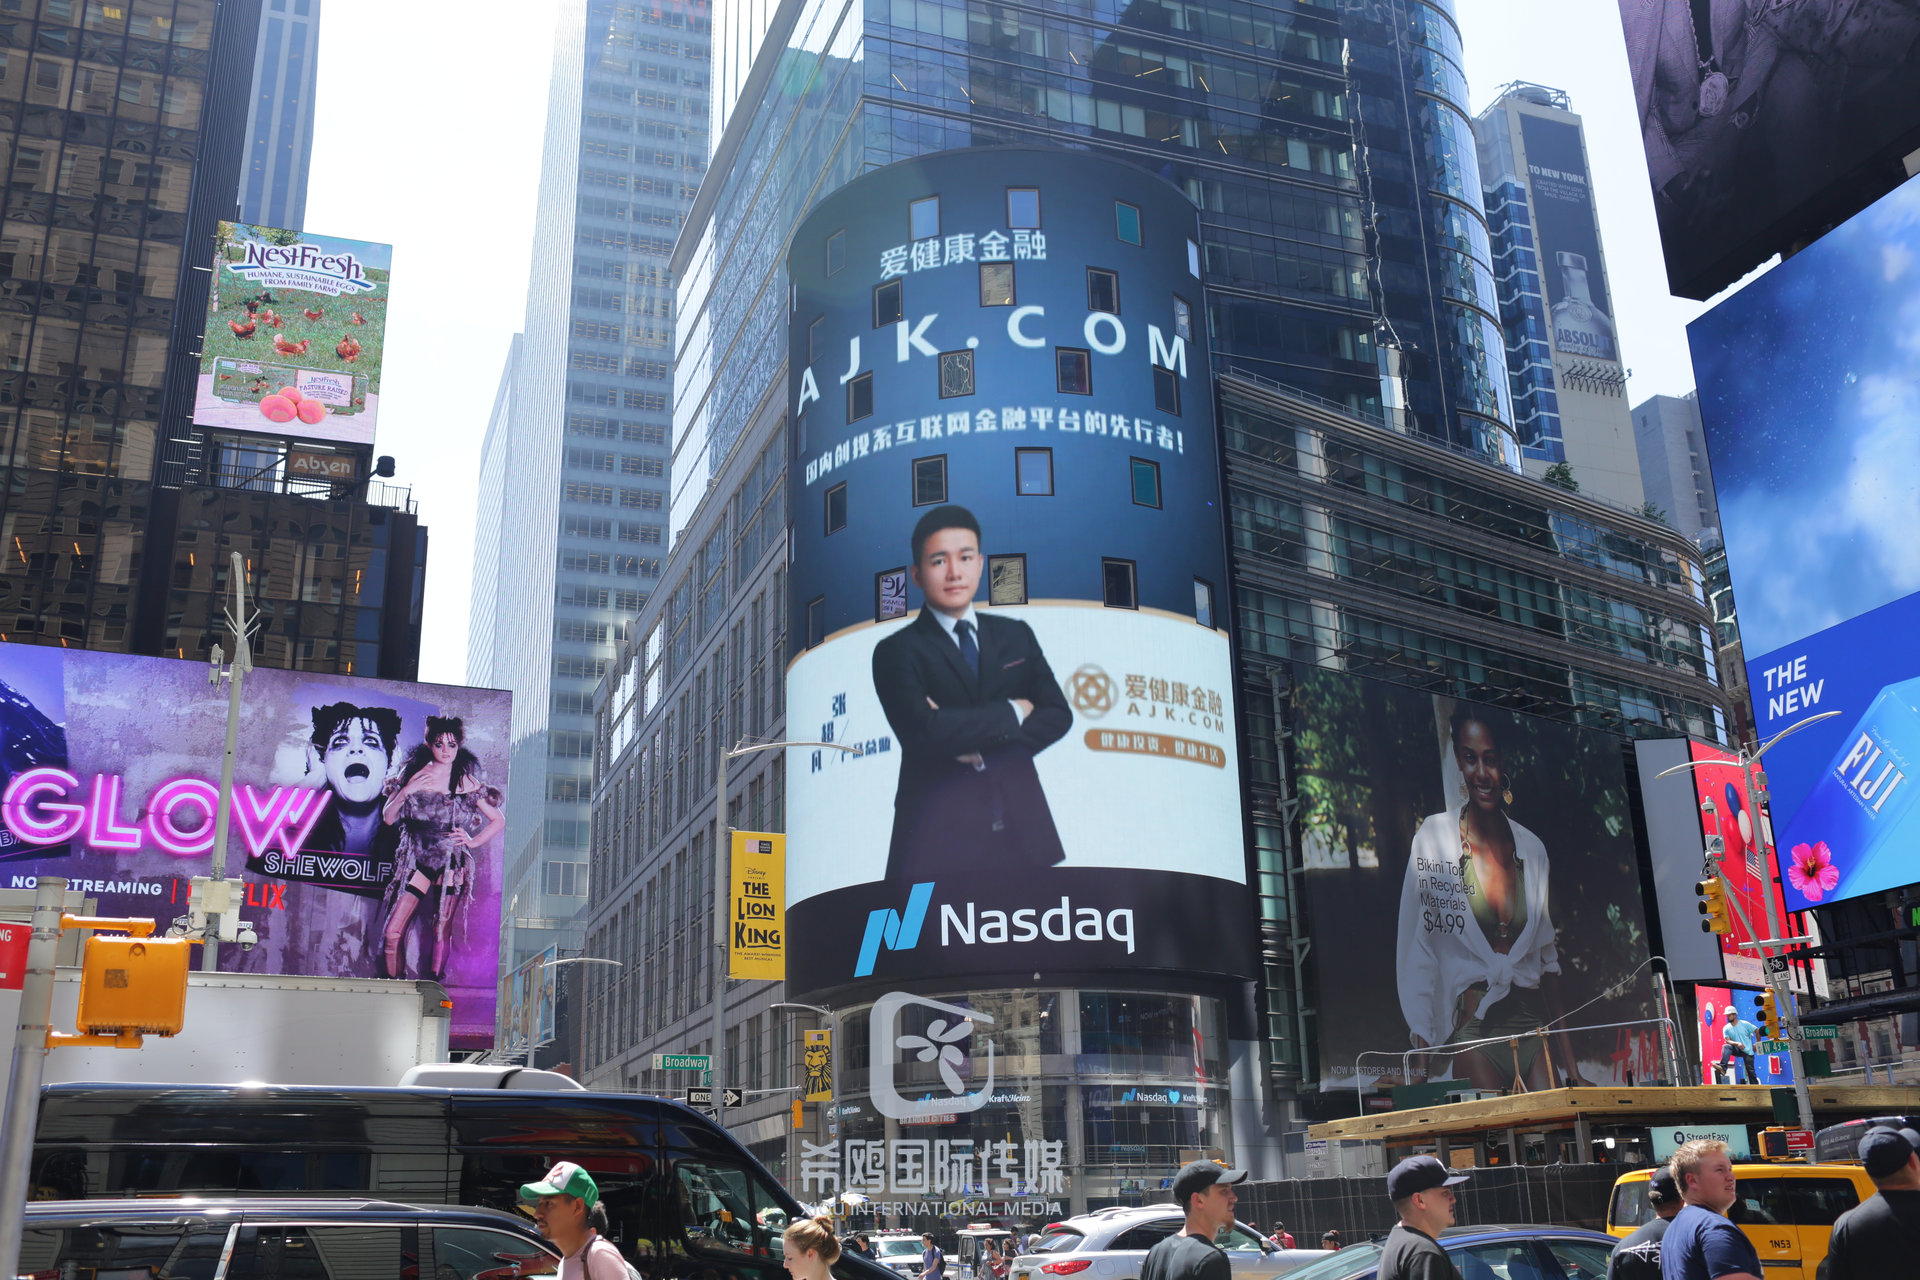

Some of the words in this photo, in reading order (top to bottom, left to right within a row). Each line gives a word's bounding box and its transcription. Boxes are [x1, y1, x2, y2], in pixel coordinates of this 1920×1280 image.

[1529, 164, 1540, 175] TO
[1541, 167, 1560, 180] NEW
[248, 243, 360, 280] NestFresh
[880, 230, 1046, 280] 爱健康金融
[286, 273, 335, 286] SUSTAINABLE
[336, 282, 356, 292] EGGS
[288, 280, 313, 290] FAMILY
[314, 284, 338, 294] FARMS
[327, 386, 349, 396] RAISED
[294, 456, 350, 475] Absen
[1763, 655, 1807, 692] THE
[1125, 674, 1223, 718] 爱健康金融
[1768, 678, 1825, 720] NEW
[1837, 731, 1906, 814] FIJI
[2, 767, 333, 860] GLOW
[264, 851, 393, 883] SHEWOLF
[1417, 857, 1444, 874] Bikini
[1446, 861, 1464, 880] Top
[65, 878, 162, 896] STREAMING
[743, 881, 769, 896] THE
[1418, 875, 1428, 889] in
[1431, 877, 1476, 896] Recycled
[1420, 892, 1467, 911] Materials
[940, 896, 1135, 954] Nasdaq
[1423, 909, 1465, 935] $4.99
[1777, 972, 1789, 980] LANE
[1805, 1026, 1836, 1037] Broadway
[1764, 1042, 1771, 1052] W
[1773, 1041, 1782, 1051] 43
[665, 1056, 708, 1070] Broadway
[1610, 1028, 1658, 1085] H&M
[1330, 1066, 1348, 1075] NOW
[1359, 1066, 1385, 1076] STORES
[1387, 1067, 1401, 1076] AND
[1403, 1068, 1428, 1077] NLINE
[694, 1093, 710, 1101] ONE
[723, 1094, 734, 1102] AY
[931, 1096, 967, 1107] Nasdaq
[1137, 1092, 1168, 1104] Nasdaq
[932, 1114, 956, 1123] CITIES
[1686, 1132, 1730, 1143] StreetEasy
[1769, 1239, 1792, 1249] 1N53
